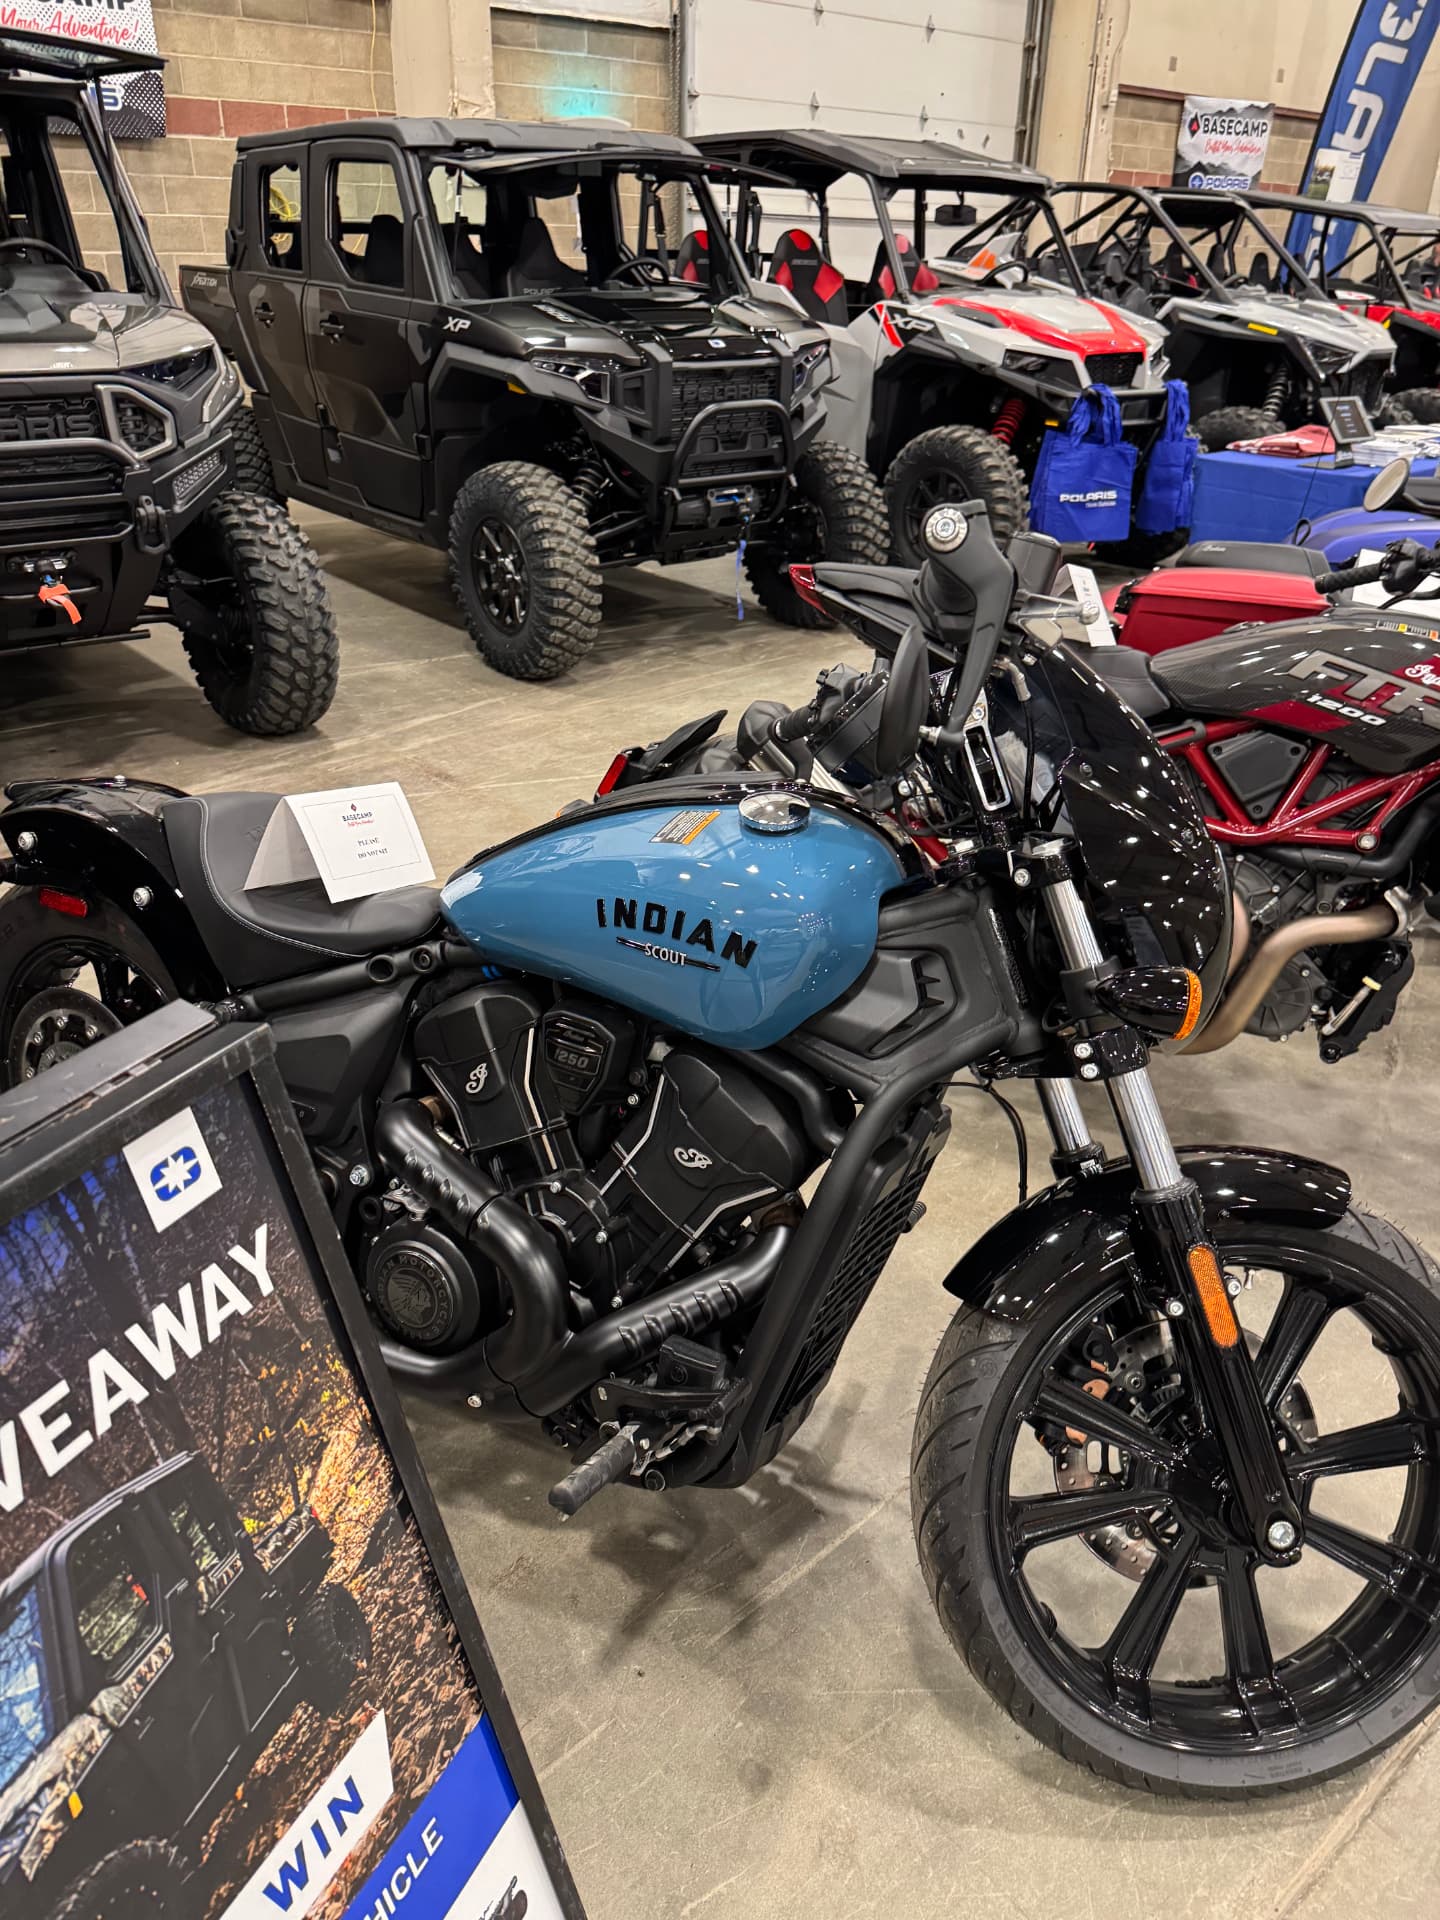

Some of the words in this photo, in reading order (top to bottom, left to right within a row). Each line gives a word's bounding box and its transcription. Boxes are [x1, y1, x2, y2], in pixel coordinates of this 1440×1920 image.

[44, 10, 140, 44] Adventure!
[1203, 117, 1268, 138] BASECAMP
[1206, 176, 1249, 189] POLARIS
[443, 316, 472, 332] XP
[887, 313, 934, 332] XP
[1059, 490, 1118, 503] POLARIS
[596, 897, 758, 969] INDIAN
[644, 942, 688, 966] SCOUT
[554, 1048, 589, 1068] 1250
[262, 1774, 364, 1913] WIN
